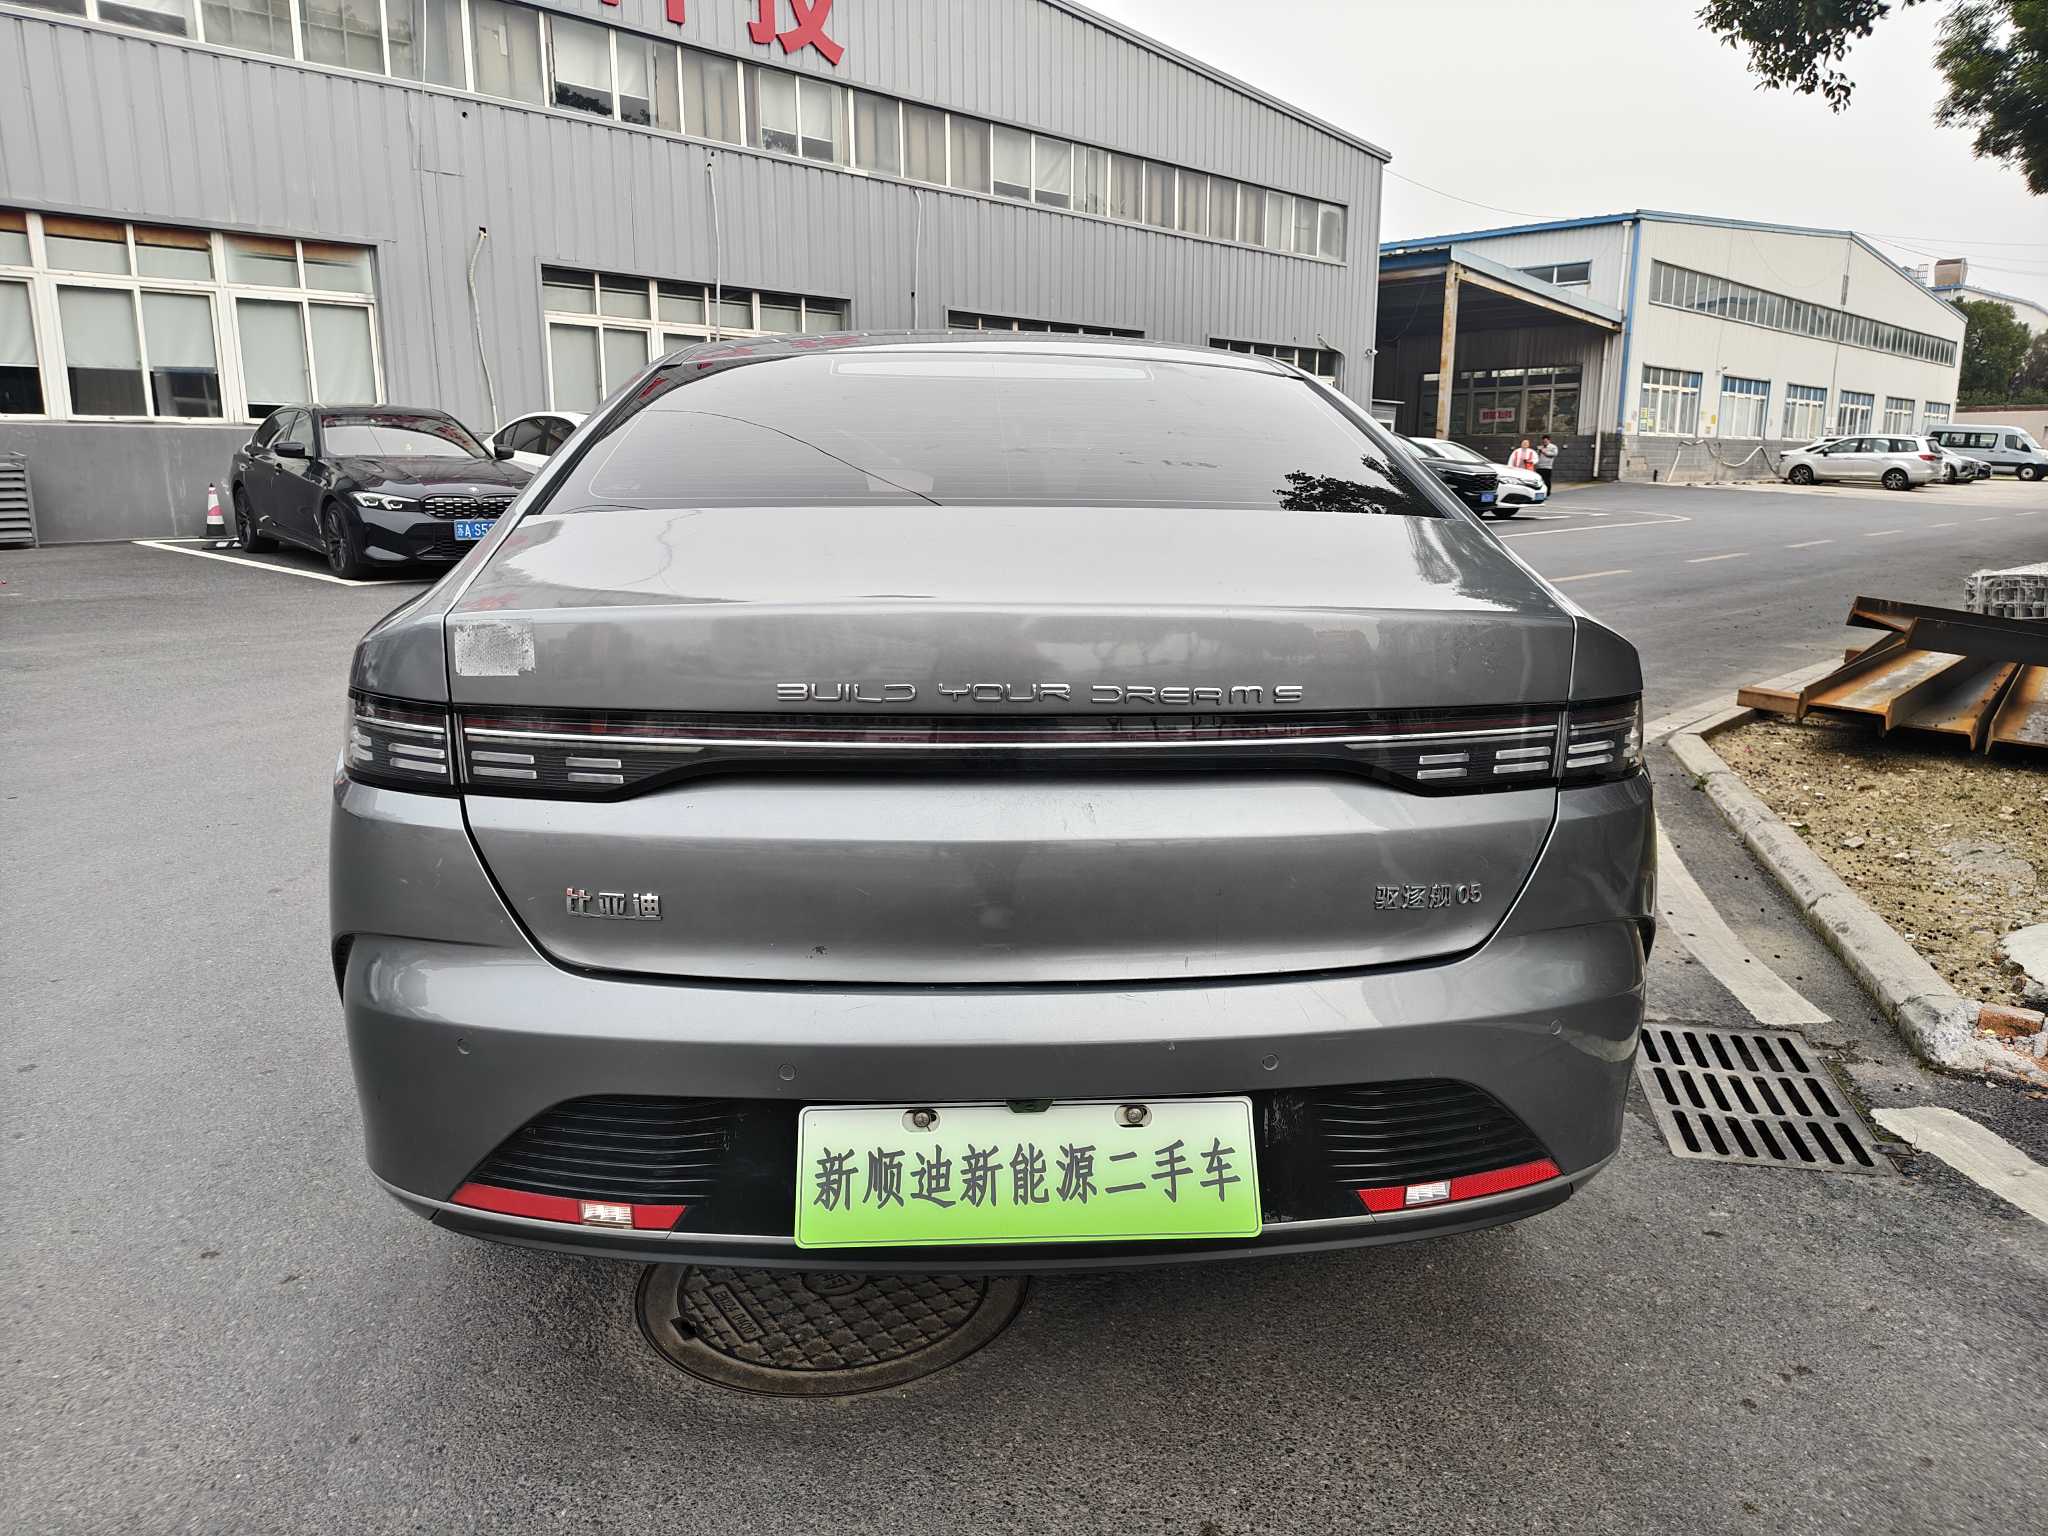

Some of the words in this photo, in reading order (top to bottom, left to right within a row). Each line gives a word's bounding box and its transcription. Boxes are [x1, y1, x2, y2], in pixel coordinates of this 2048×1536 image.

[776, 683, 917, 703] BUILD
[938, 683, 1071, 702] YOUR
[1091, 685, 1304, 705] DREAMS
[566, 887, 662, 920] 比亚迪
[813, 1136, 1242, 1212] 新顺迪新能源二手车
